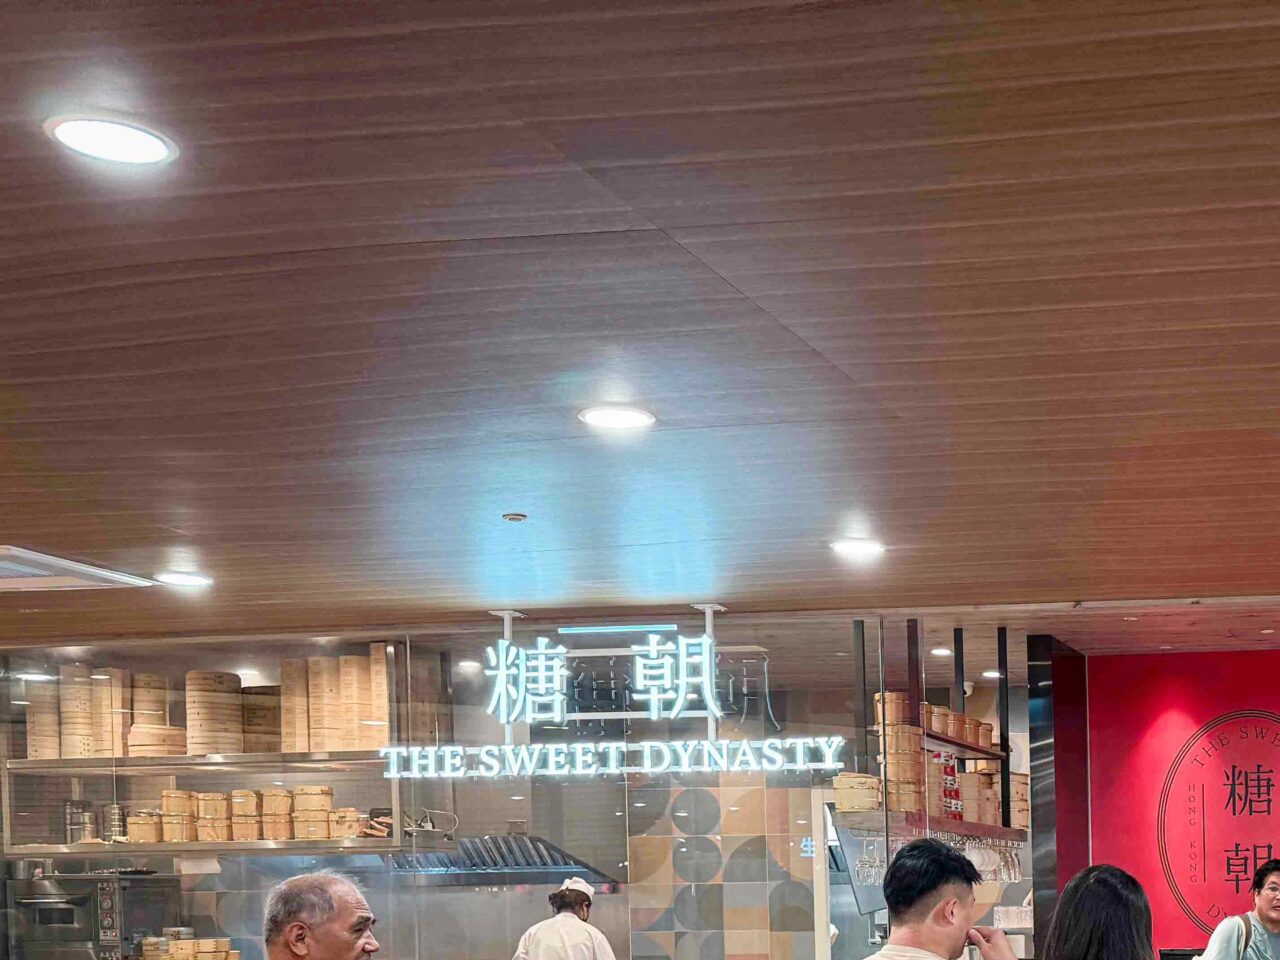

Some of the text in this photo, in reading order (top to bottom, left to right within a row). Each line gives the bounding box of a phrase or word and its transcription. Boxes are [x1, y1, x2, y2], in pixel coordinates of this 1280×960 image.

[485, 634, 722, 724] 糖朝
[380, 736, 844, 778] THE SWEET DYNASTY
[1191, 731, 1230, 769] THE
[1188, 784, 1197, 884] HONG KONG
[1223, 764, 1275, 894] 糖朝
